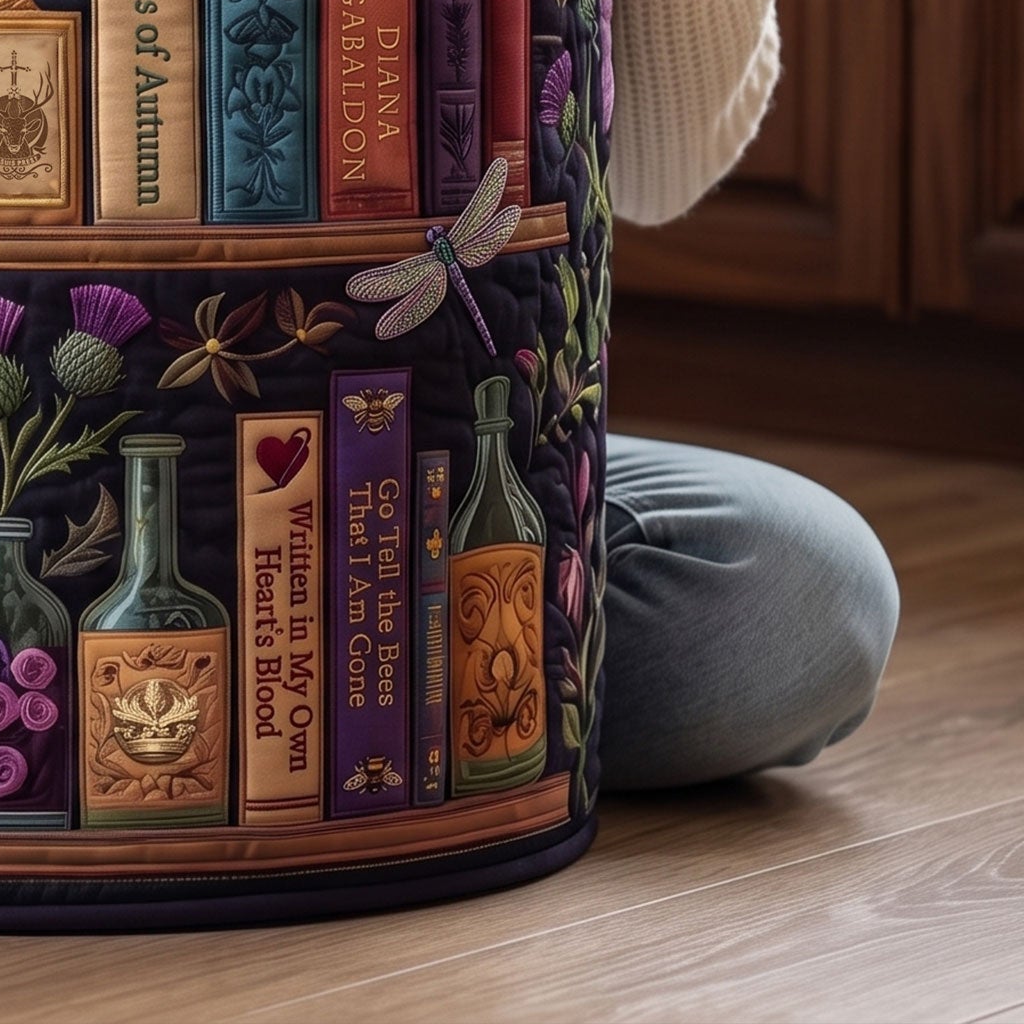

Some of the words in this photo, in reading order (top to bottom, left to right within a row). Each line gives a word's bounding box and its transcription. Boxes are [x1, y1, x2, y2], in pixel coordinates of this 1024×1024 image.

[134, 23, 171, 63] of
[377, 24, 401, 141] DIANA
[134, 66, 169, 207] Autumn
[378, 478, 400, 519] Go
[289, 499, 314, 607] Written
[349, 554, 372, 566] I
[378, 525, 401, 580] Tell
[349, 574, 372, 624] Am
[378, 590, 402, 633] the
[289, 615, 315, 643] in
[254, 656, 283, 740] Blood
[282, 650, 314, 697] My
[348, 633, 372, 708] Gone
[378, 642, 400, 707] Bees
[289, 704, 314, 773] Own
